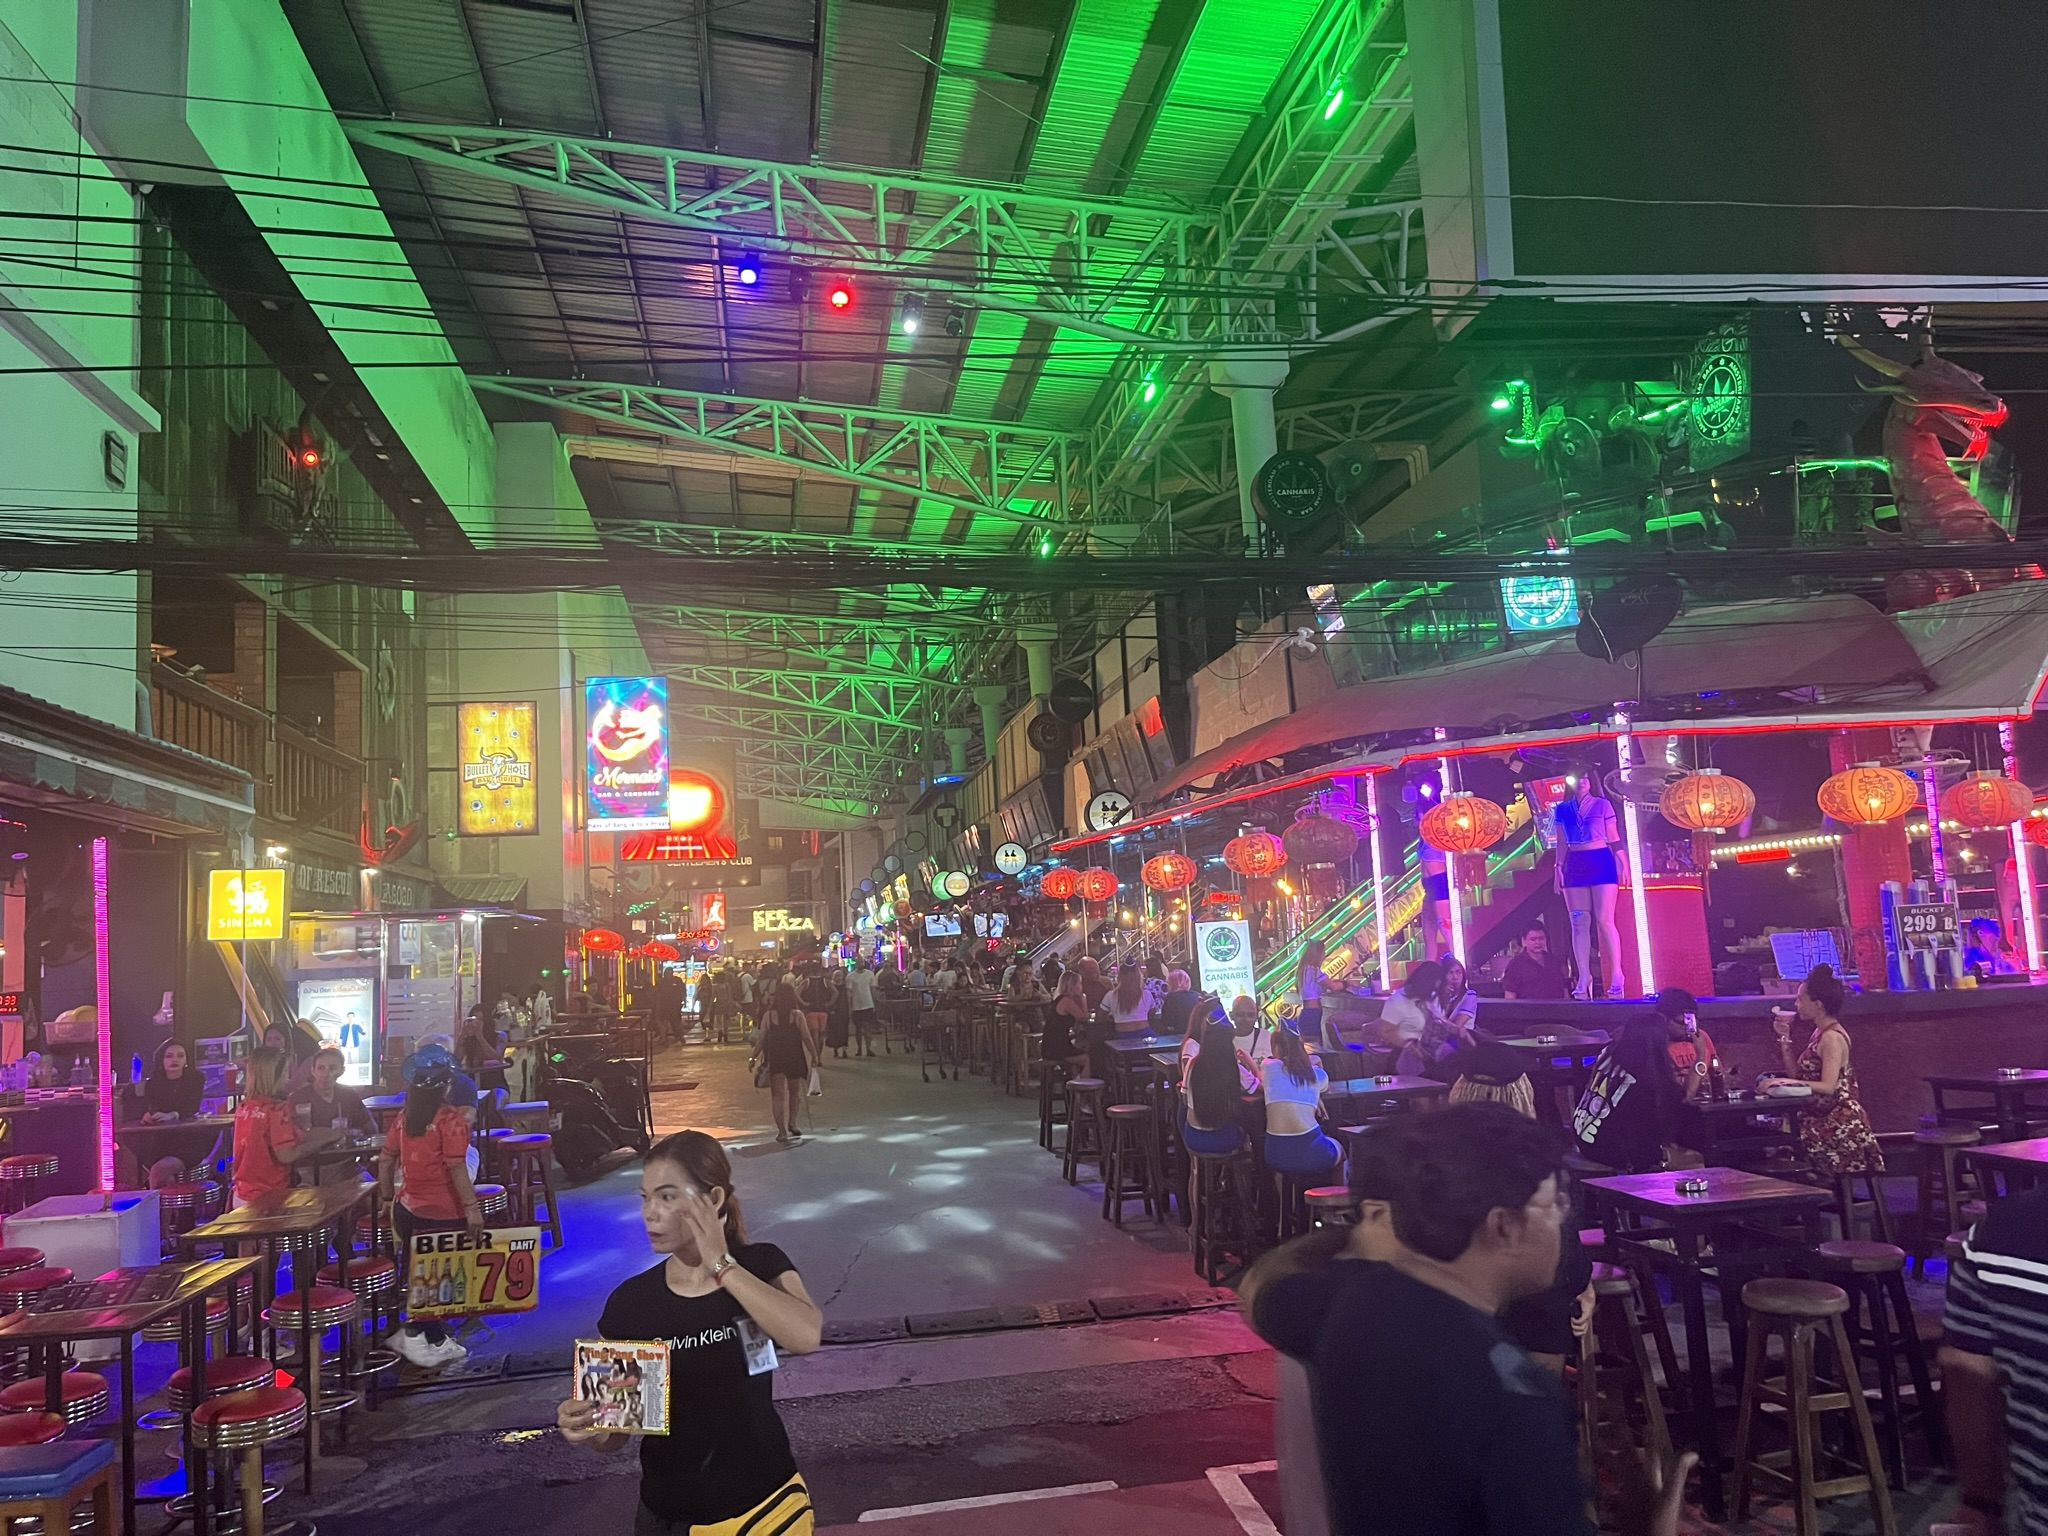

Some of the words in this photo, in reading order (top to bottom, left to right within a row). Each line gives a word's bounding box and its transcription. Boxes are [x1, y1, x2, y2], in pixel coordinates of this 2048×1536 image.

[1277, 488, 1315, 496] CANNABIS
[466, 765, 489, 777] BULLET
[507, 764, 527, 776] HOLE
[593, 766, 663, 790] Mermaid
[729, 856, 753, 866] CLUB
[753, 909, 788, 921] KEE
[1910, 906, 1946, 915] BUCKET
[217, 917, 273, 929] SINGHA
[753, 917, 815, 932] PLAZA
[1902, 914, 1937, 932] 299
[677, 931, 696, 940] SEXY
[1205, 971, 1249, 982] CANNABIS
[416, 1231, 493, 1255] BEER
[510, 1239, 535, 1251] BAHT
[475, 1251, 535, 1304] 79
[700, 1325, 738, 1347] Klein
[636, 1348, 665, 1361] Show
